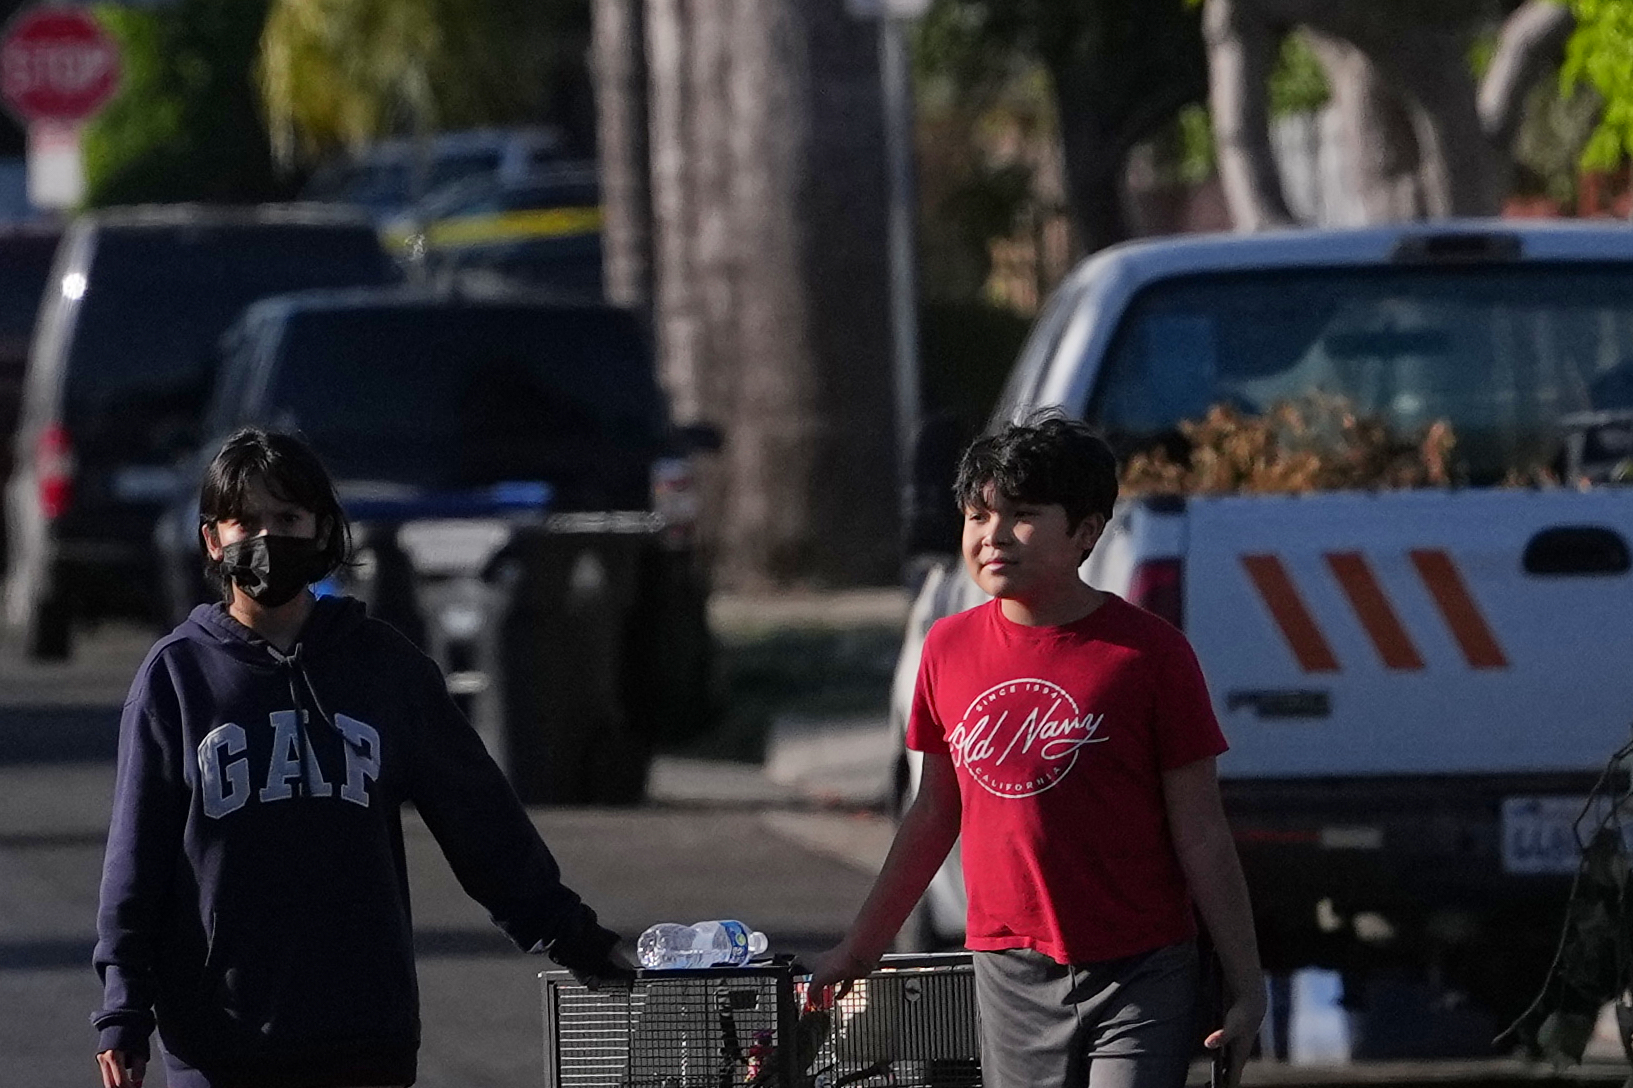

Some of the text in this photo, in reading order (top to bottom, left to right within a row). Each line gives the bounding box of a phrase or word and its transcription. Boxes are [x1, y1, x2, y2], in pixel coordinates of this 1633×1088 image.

[0, 45, 107, 90] STOP
[975, 683, 1059, 712] SINCE 1994
[948, 698, 1110, 768] Old Navy
[197, 709, 381, 820] GAP
[975, 766, 1061, 791] CALIFORNIA
